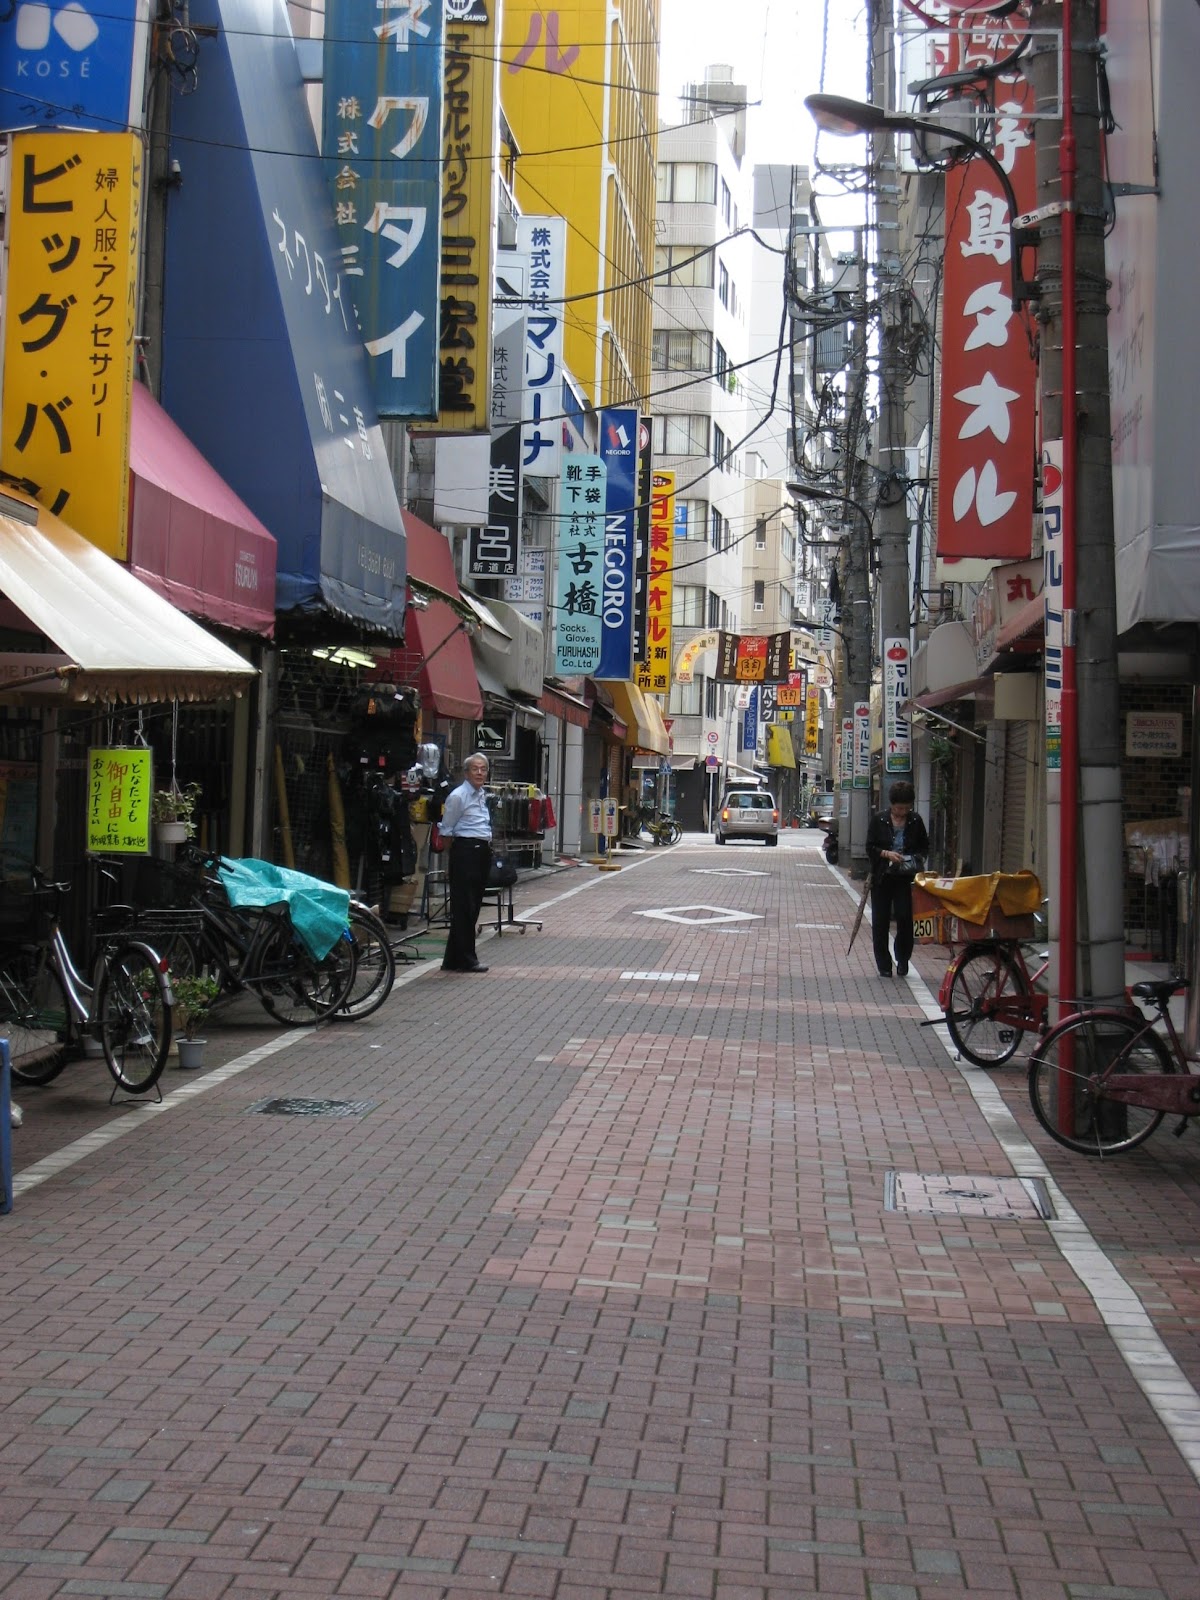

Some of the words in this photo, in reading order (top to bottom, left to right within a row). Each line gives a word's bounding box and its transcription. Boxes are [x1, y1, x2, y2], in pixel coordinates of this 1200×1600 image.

[17, 57, 91, 78] KOSÉ
[335, 97, 364, 277] 株式会社三
[363, 0, 432, 378] ネクタイ
[88, 168, 120, 437] 婦人服・アクセサリー
[529, 228, 551, 310] 株式会社
[491, 346, 508, 418] 株式会社
[524, 317, 557, 466] マリーナ
[566, 465, 582, 503] 靴下
[585, 465, 601, 503] 手袋
[472, 561, 514, 574] 新道店
[562, 542, 600, 617] 古橋
[603, 515, 626, 628] NEGORO
[557, 646, 599, 659] FURUHASHI
[654, 646, 667, 688] 新道
[762, 685, 773, 720] バッグ
[91, 758, 104, 825] お入り下さい
[106, 760, 128, 833] 御自由に
[128, 759, 144, 823] どなたでも
[914, 920, 932, 938] 250
